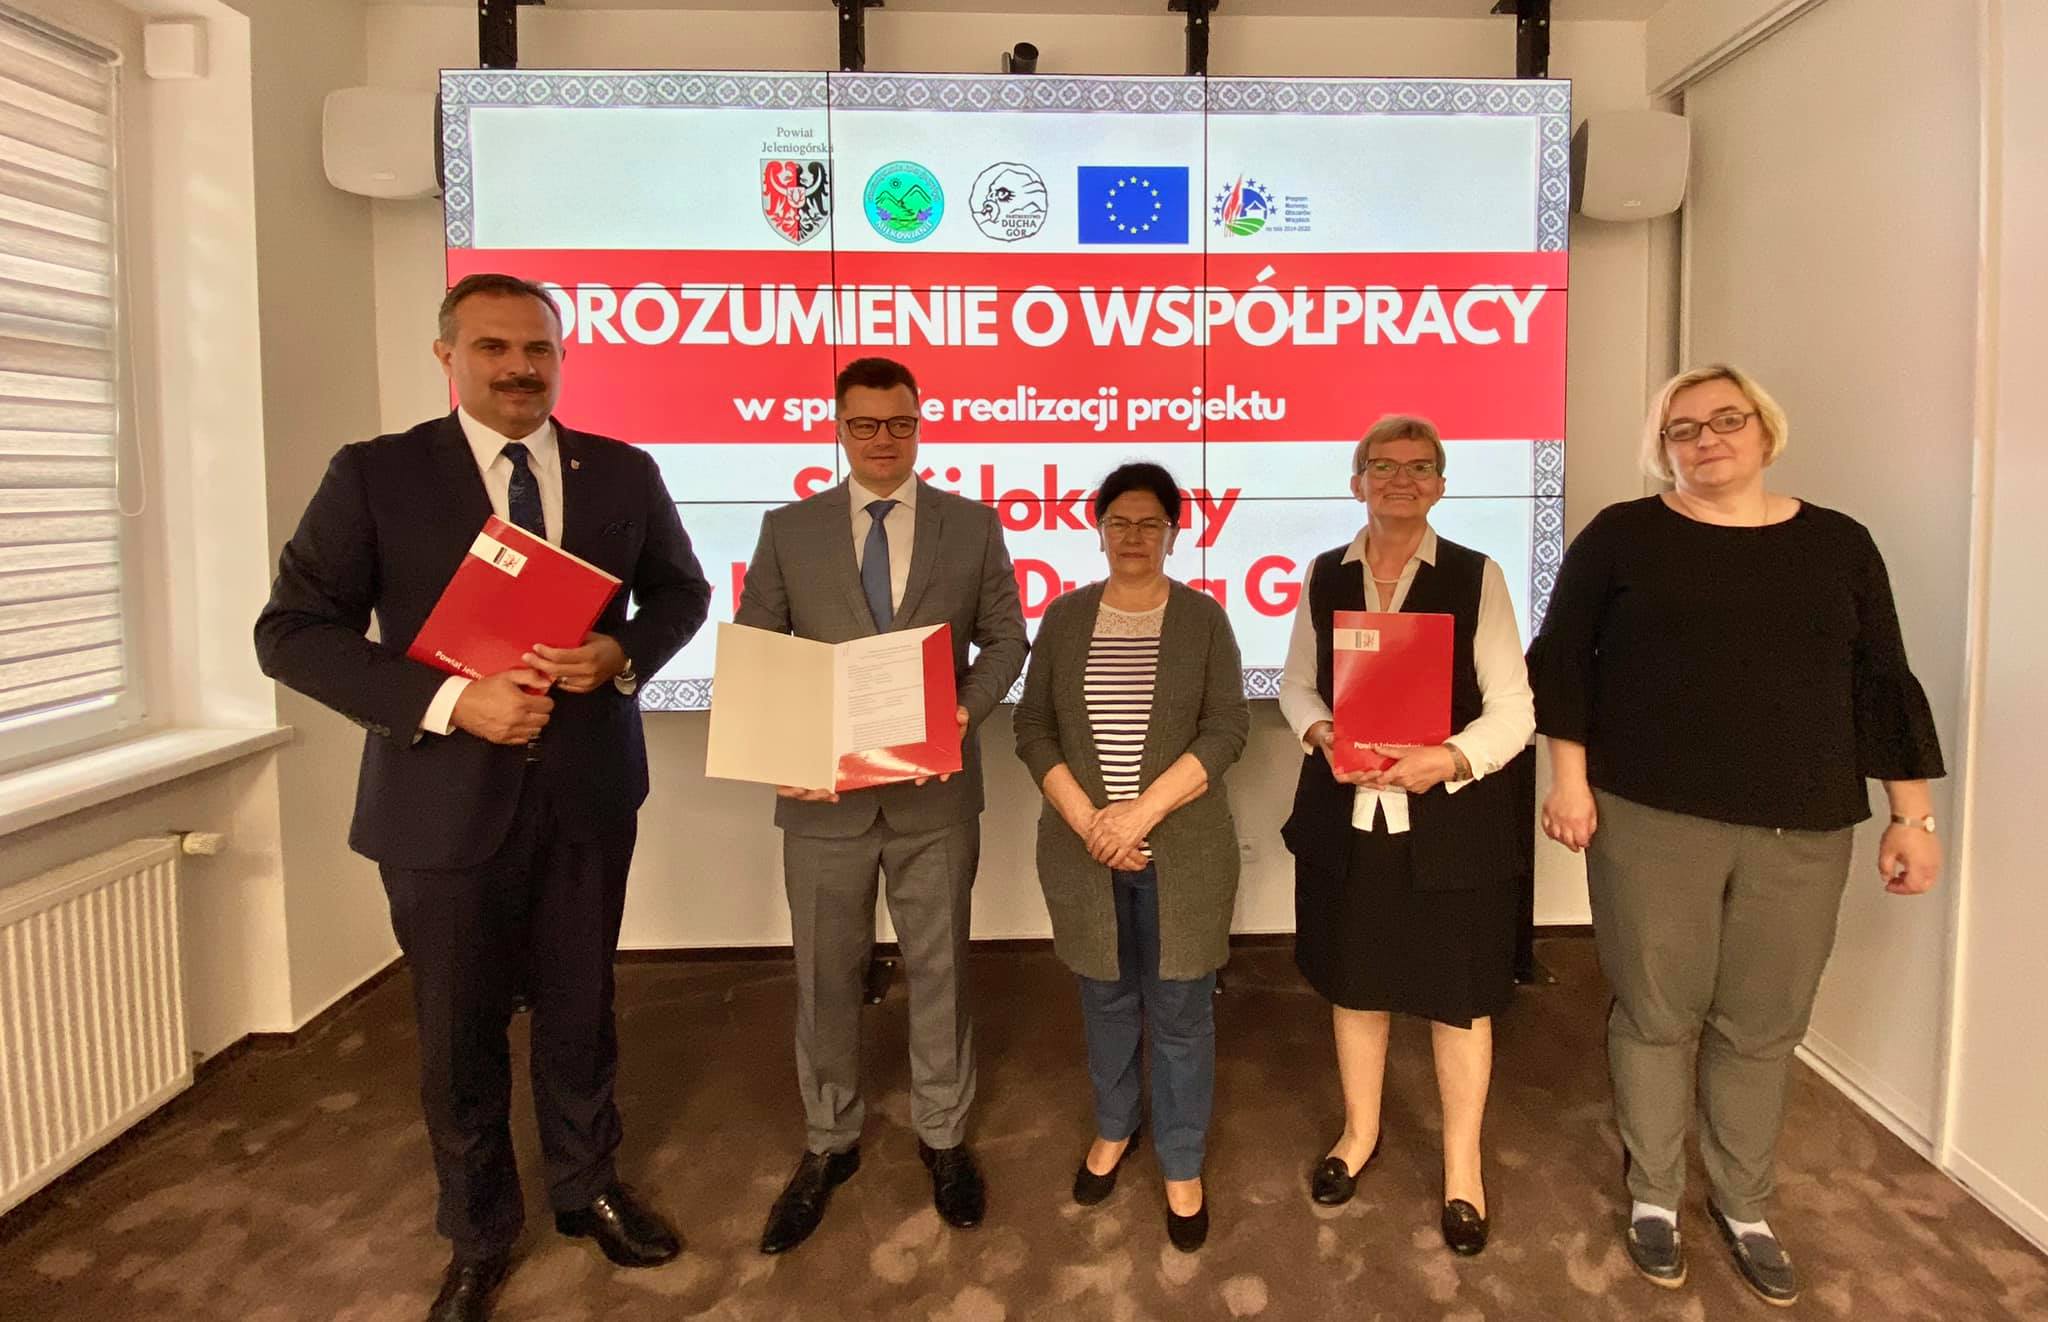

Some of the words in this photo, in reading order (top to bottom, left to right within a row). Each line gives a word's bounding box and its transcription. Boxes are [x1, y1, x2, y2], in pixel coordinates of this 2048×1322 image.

[776, 127, 814, 138] Powiat
[1001, 219, 1037, 228] DUCHA
[1006, 228, 1027, 237] GÓR
[1012, 285, 1069, 347] O
[1079, 265, 1549, 347] WSPÓŁPRACY
[733, 397, 776, 422] w
[953, 386, 1118, 432] realizacji
[1127, 385, 1287, 432] projektu
[435, 650, 463, 670] Powiat
